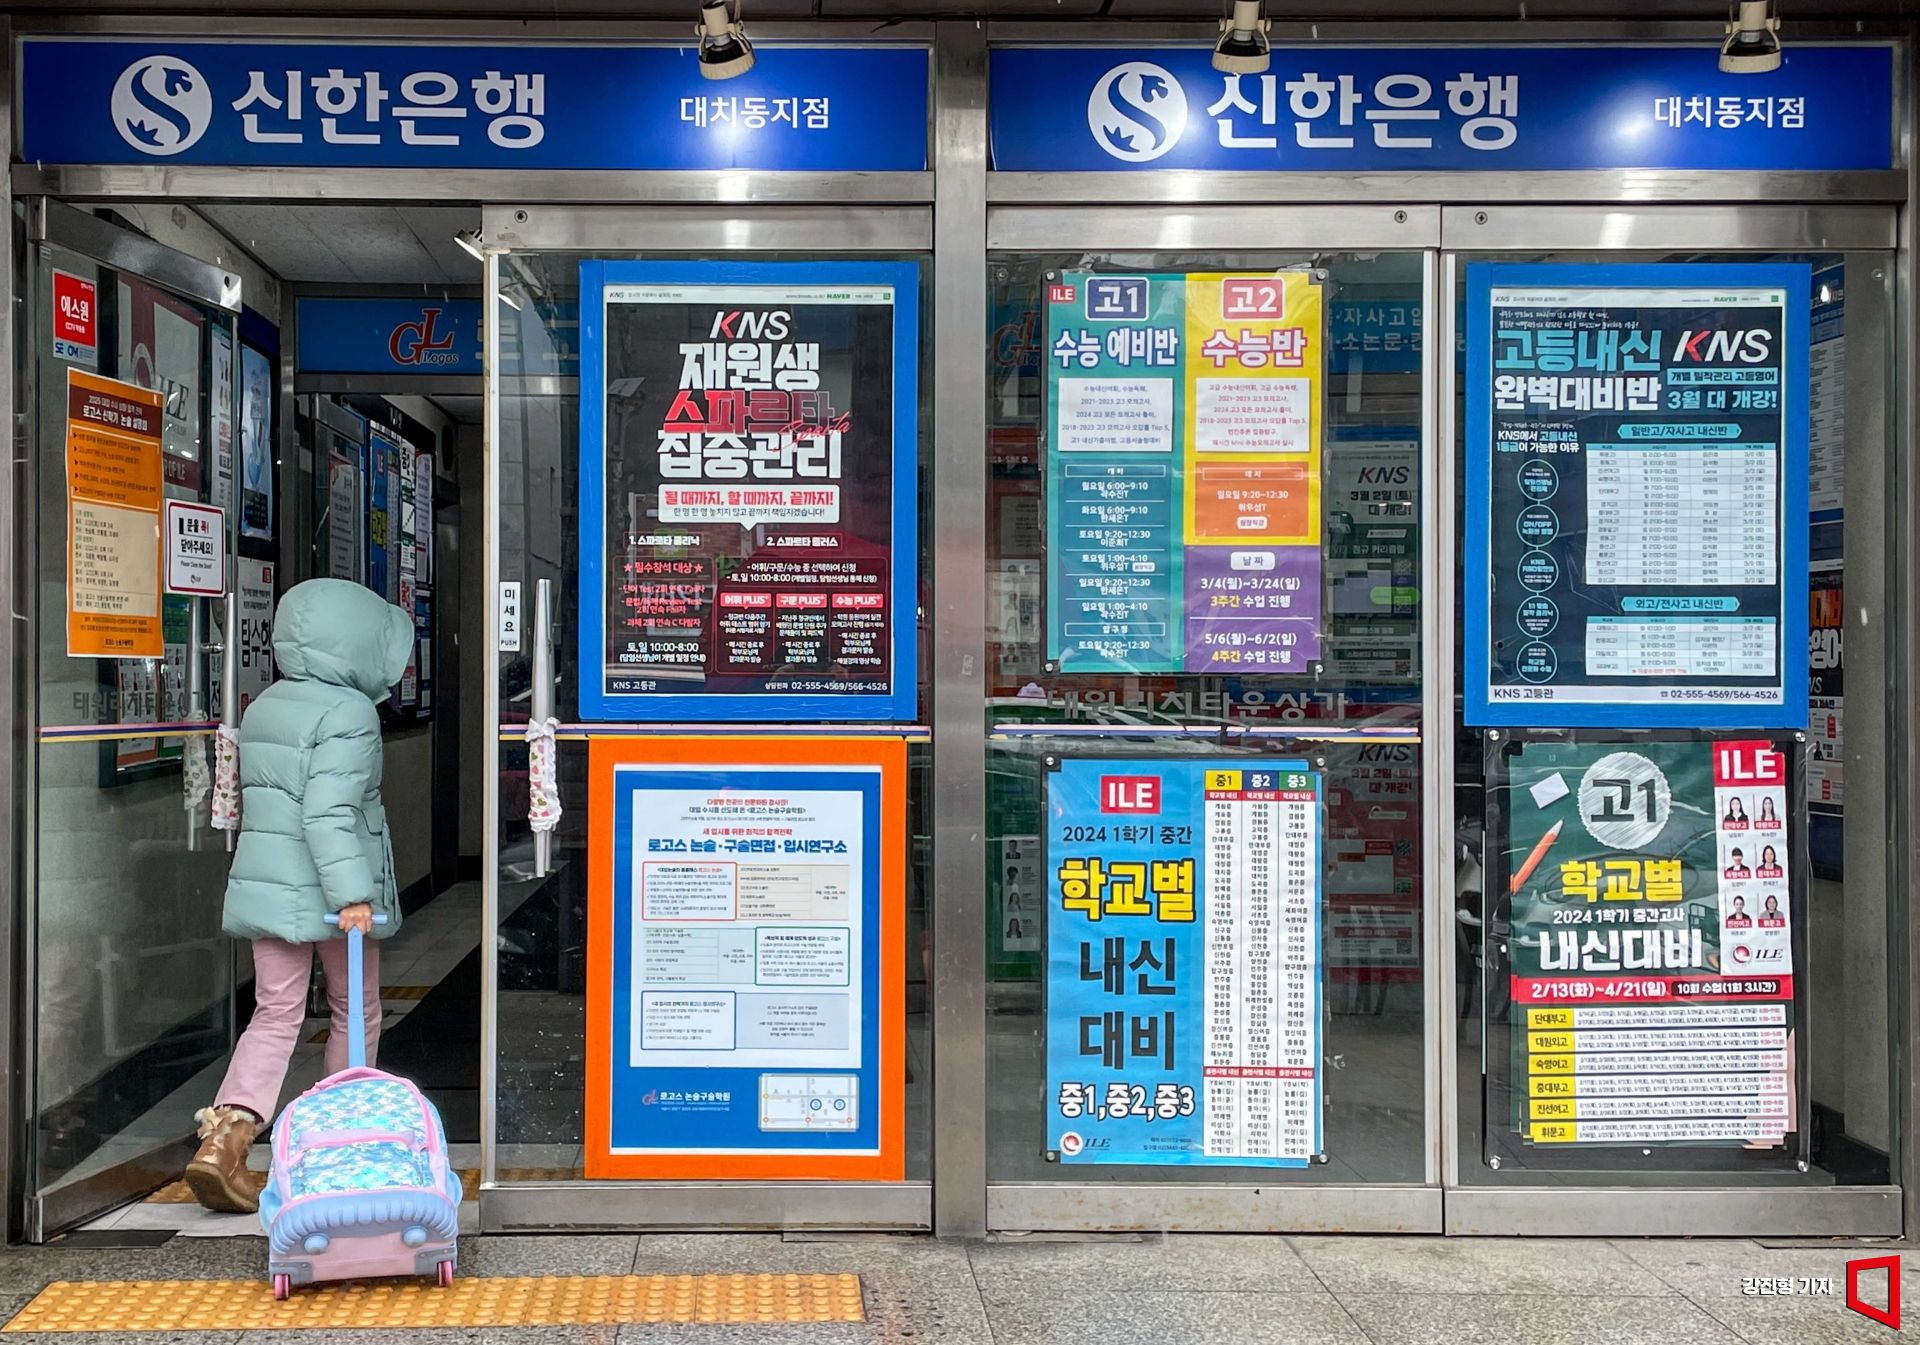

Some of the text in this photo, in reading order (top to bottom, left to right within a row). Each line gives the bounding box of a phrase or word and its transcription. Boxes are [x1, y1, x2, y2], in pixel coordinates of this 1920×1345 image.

[232, 70, 545, 149] 신한은행
[680, 96, 830, 129] 대치동지점
[1207, 73, 1519, 150] 신한은행
[1654, 95, 1806, 129] 대치동지점
[1052, 288, 1073, 300] ILE
[1095, 287, 1138, 313] 고1
[1228, 286, 1277, 313] 고2
[61, 295, 88, 322] 에스원
[709, 311, 791, 340] KNS
[1054, 327, 1179, 368] 수능 예비반
[1202, 328, 1306, 367] 수능반
[1495, 330, 1662, 371] 고등내신
[1672, 329, 1772, 363] KNS
[422, 351, 459, 365] Logos
[679, 343, 820, 391] 재원생
[1672, 371, 1775, 381] 개별 밀착관리 고등영어
[1495, 375, 1663, 411] 완벽대비반
[1667, 390, 1777, 409] 3월 대 개강!
[83, 405, 102, 419] 로고스
[664, 390, 836, 433] 스파르타
[1498, 430, 1578, 442] KNS에서 고등내신
[1631, 426, 1728, 437] 일반고/자사고 내신반
[657, 429, 841, 478] 집중관리
[1530, 442, 1558, 453] 가능한
[1559, 442, 1580, 453] 이유
[1358, 467, 1410, 484] KNS
[1082, 481, 1105, 491] 월요일
[681, 491, 724, 506] 때까지,
[728, 491, 740, 505] 할
[744, 491, 787, 506] 때까지,
[790, 491, 834, 505] 끝까지!
[1217, 490, 1240, 500] 일요일
[1350, 491, 1370, 501] 3월
[1373, 491, 1392, 501] 2일
[674, 508, 681, 517] 한
[692, 508, 699, 517] 한
[709, 508, 731, 517] 놓치지
[732, 508, 747, 517] 않고
[749, 508, 771, 517] 끝까지
[772, 508, 825, 517] 책임지겠습니다!
[1082, 506, 1105, 515] 화요일
[187, 518, 199, 533] 문을
[629, 535, 636, 545] 1.
[638, 535, 673, 545] 스파르타
[767, 537, 775, 546] 2.
[777, 537, 811, 546] 스파르타
[1079, 530, 1102, 539] 토요일
[181, 539, 213, 555] 닫아주세요!
[634, 562, 692, 574] 필수참석 대상
[752, 563, 857, 573] 어휘/구문/수능 중 선택하여 신청
[1201, 577, 1301, 590] 3/4(월)~3/24(일)
[1211, 595, 1291, 608] 3주간 수업 진행
[1635, 599, 1724, 610] 외고/전사고 내신반
[504, 589, 515, 632] 미세요
[1205, 633, 1297, 646] 5/6(월)~6/2(일)
[1212, 651, 1291, 664] 4주간 수업 진행
[613, 681, 656, 690] KNS 고등관
[792, 682, 888, 691] 02-555-4569/566-4526
[1494, 688, 1554, 700] KNS 고등관
[1671, 690, 1778, 700] 02-555-4569/566-4526
[1721, 748, 1777, 779] ILE
[1216, 774, 1232, 787] 중1
[1251, 774, 1271, 788] 중2
[1288, 774, 1307, 788] 중3
[1109, 783, 1152, 808] ILE
[1591, 778, 1657, 823] 고1
[1063, 826, 1192, 844] 2024 1학기 중간
[648, 839, 687, 852] 로고스
[1560, 860, 1683, 903] 학교별
[1059, 858, 1196, 921] 학교별
[1553, 908, 1685, 924] 2024 1학기 중간고사
[1539, 929, 1702, 971] 내신대비
[1080, 937, 1176, 995] 내신
[1531, 982, 1666, 998] 2/13(화)~4/21(일)
[1678, 984, 1700, 994] 10회
[1745, 982, 1777, 993] 3시간)
[1079, 1011, 1175, 1070] 대비
[1536, 1060, 1568, 1070] 숙명여고
[1536, 1083, 1568, 1092] 중대부고
[660, 1092, 683, 1101] 로고스
[1537, 1104, 1568, 1114] 진선여고
[1542, 1127, 1565, 1137] 휘문고
